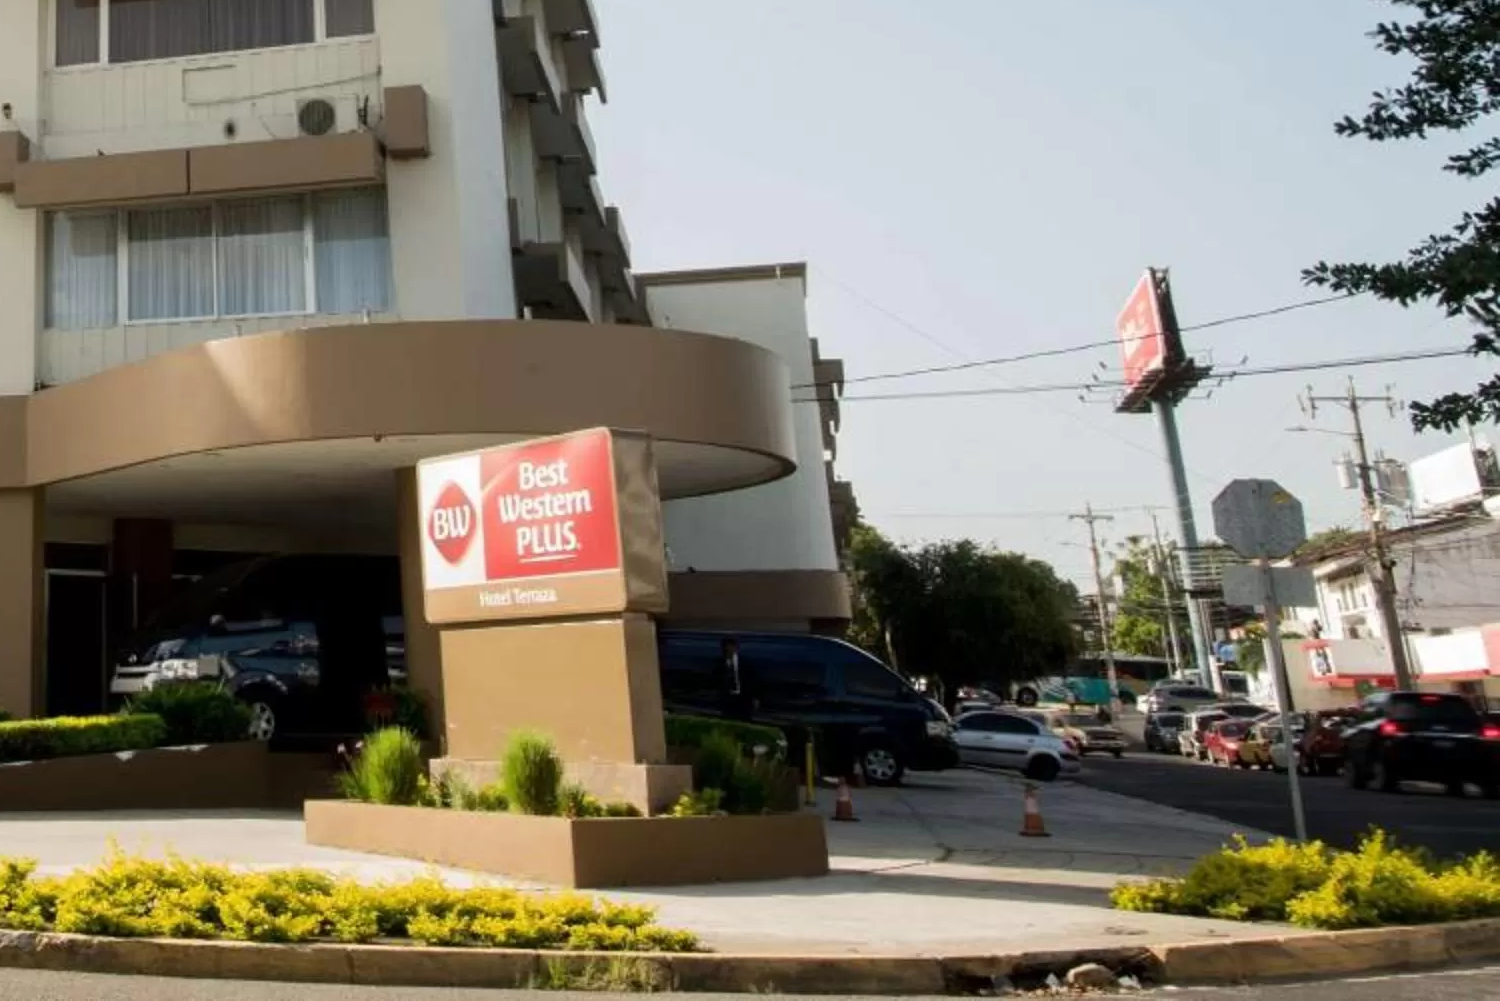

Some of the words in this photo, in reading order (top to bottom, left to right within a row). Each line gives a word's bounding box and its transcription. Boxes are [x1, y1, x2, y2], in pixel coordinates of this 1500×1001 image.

[519, 460, 568, 490] Best
[432, 504, 471, 540] BW
[498, 489, 592, 523] Western
[516, 520, 577, 555] PLUS
[479, 589, 512, 607] Hotel
